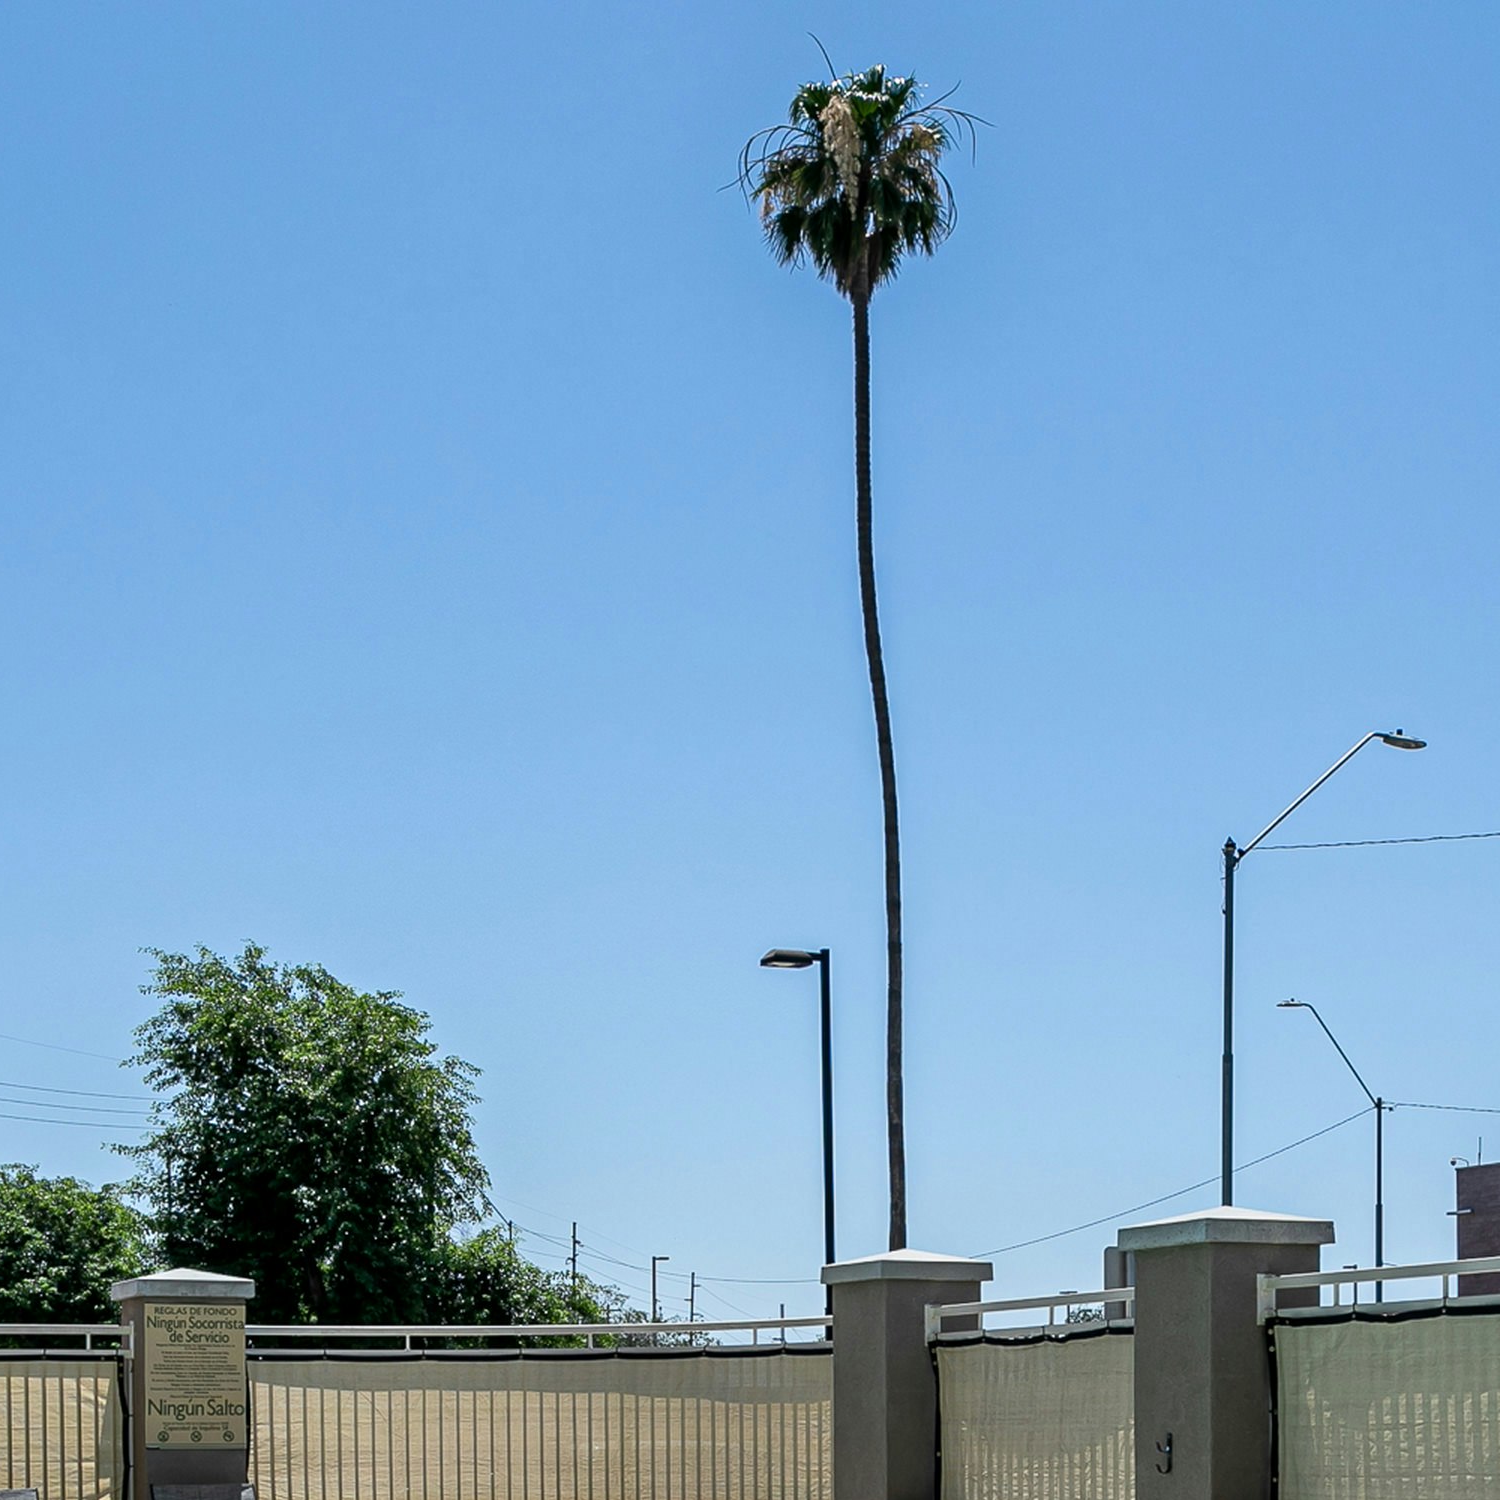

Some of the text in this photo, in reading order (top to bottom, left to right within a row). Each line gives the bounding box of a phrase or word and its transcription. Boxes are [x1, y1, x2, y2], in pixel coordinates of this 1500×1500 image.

[154, 1307, 237, 1316] REGLAS DE FONDO
[147, 1315, 245, 1332] Ningún Socorrista
[169, 1330, 229, 1343] de Servicio
[148, 1398, 244, 1421] Ningún Salto
